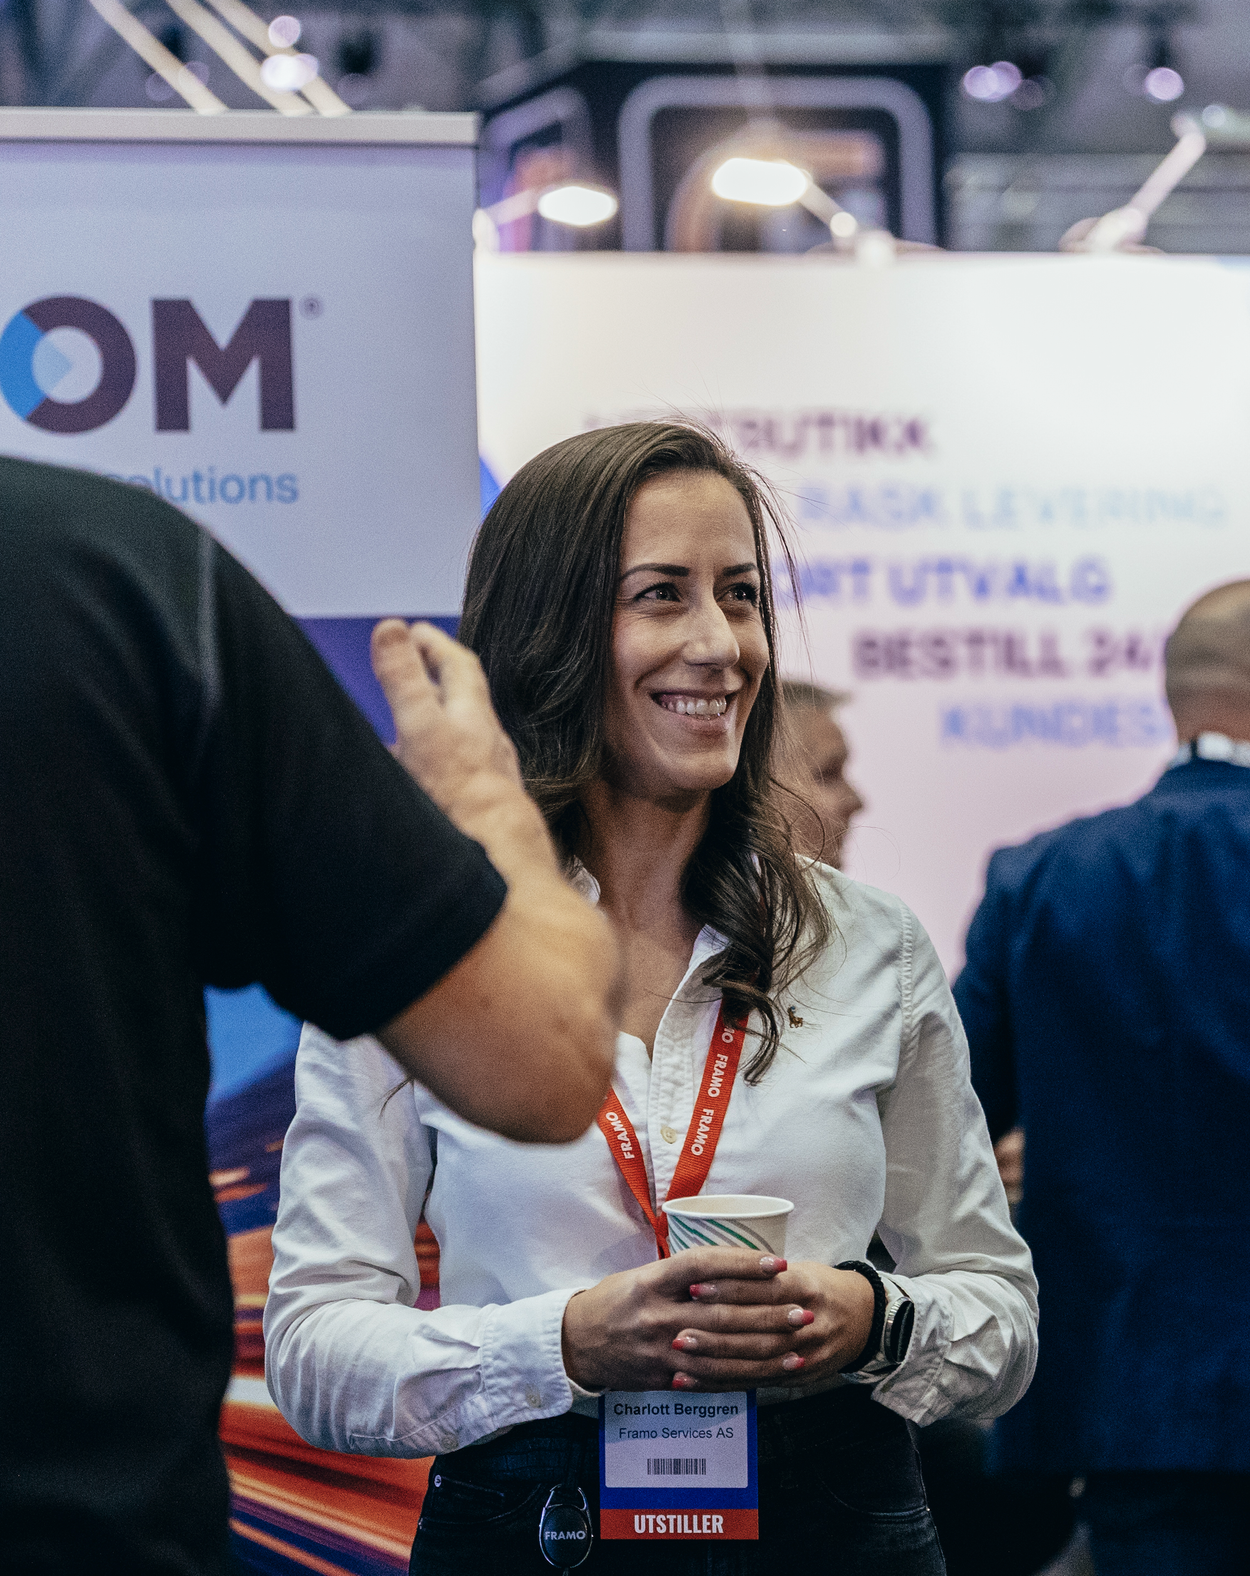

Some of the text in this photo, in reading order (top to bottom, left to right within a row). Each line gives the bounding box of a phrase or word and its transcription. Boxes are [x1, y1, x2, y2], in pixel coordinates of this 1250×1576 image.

[101, 467, 298, 504] lutions
[888, 556, 1112, 606] UTVALG
[852, 626, 1070, 684] BESTILL
[707, 1053, 729, 1098] FRAMO
[605, 1111, 635, 1160] FRAMO
[690, 1108, 715, 1156] FRAMO
[613, 1403, 739, 1419] Charlott Berggren
[619, 1427, 734, 1439] Framo Services AS
[544, 1530, 586, 1541] FRAMO
[633, 1514, 724, 1534] UTSTILLER
